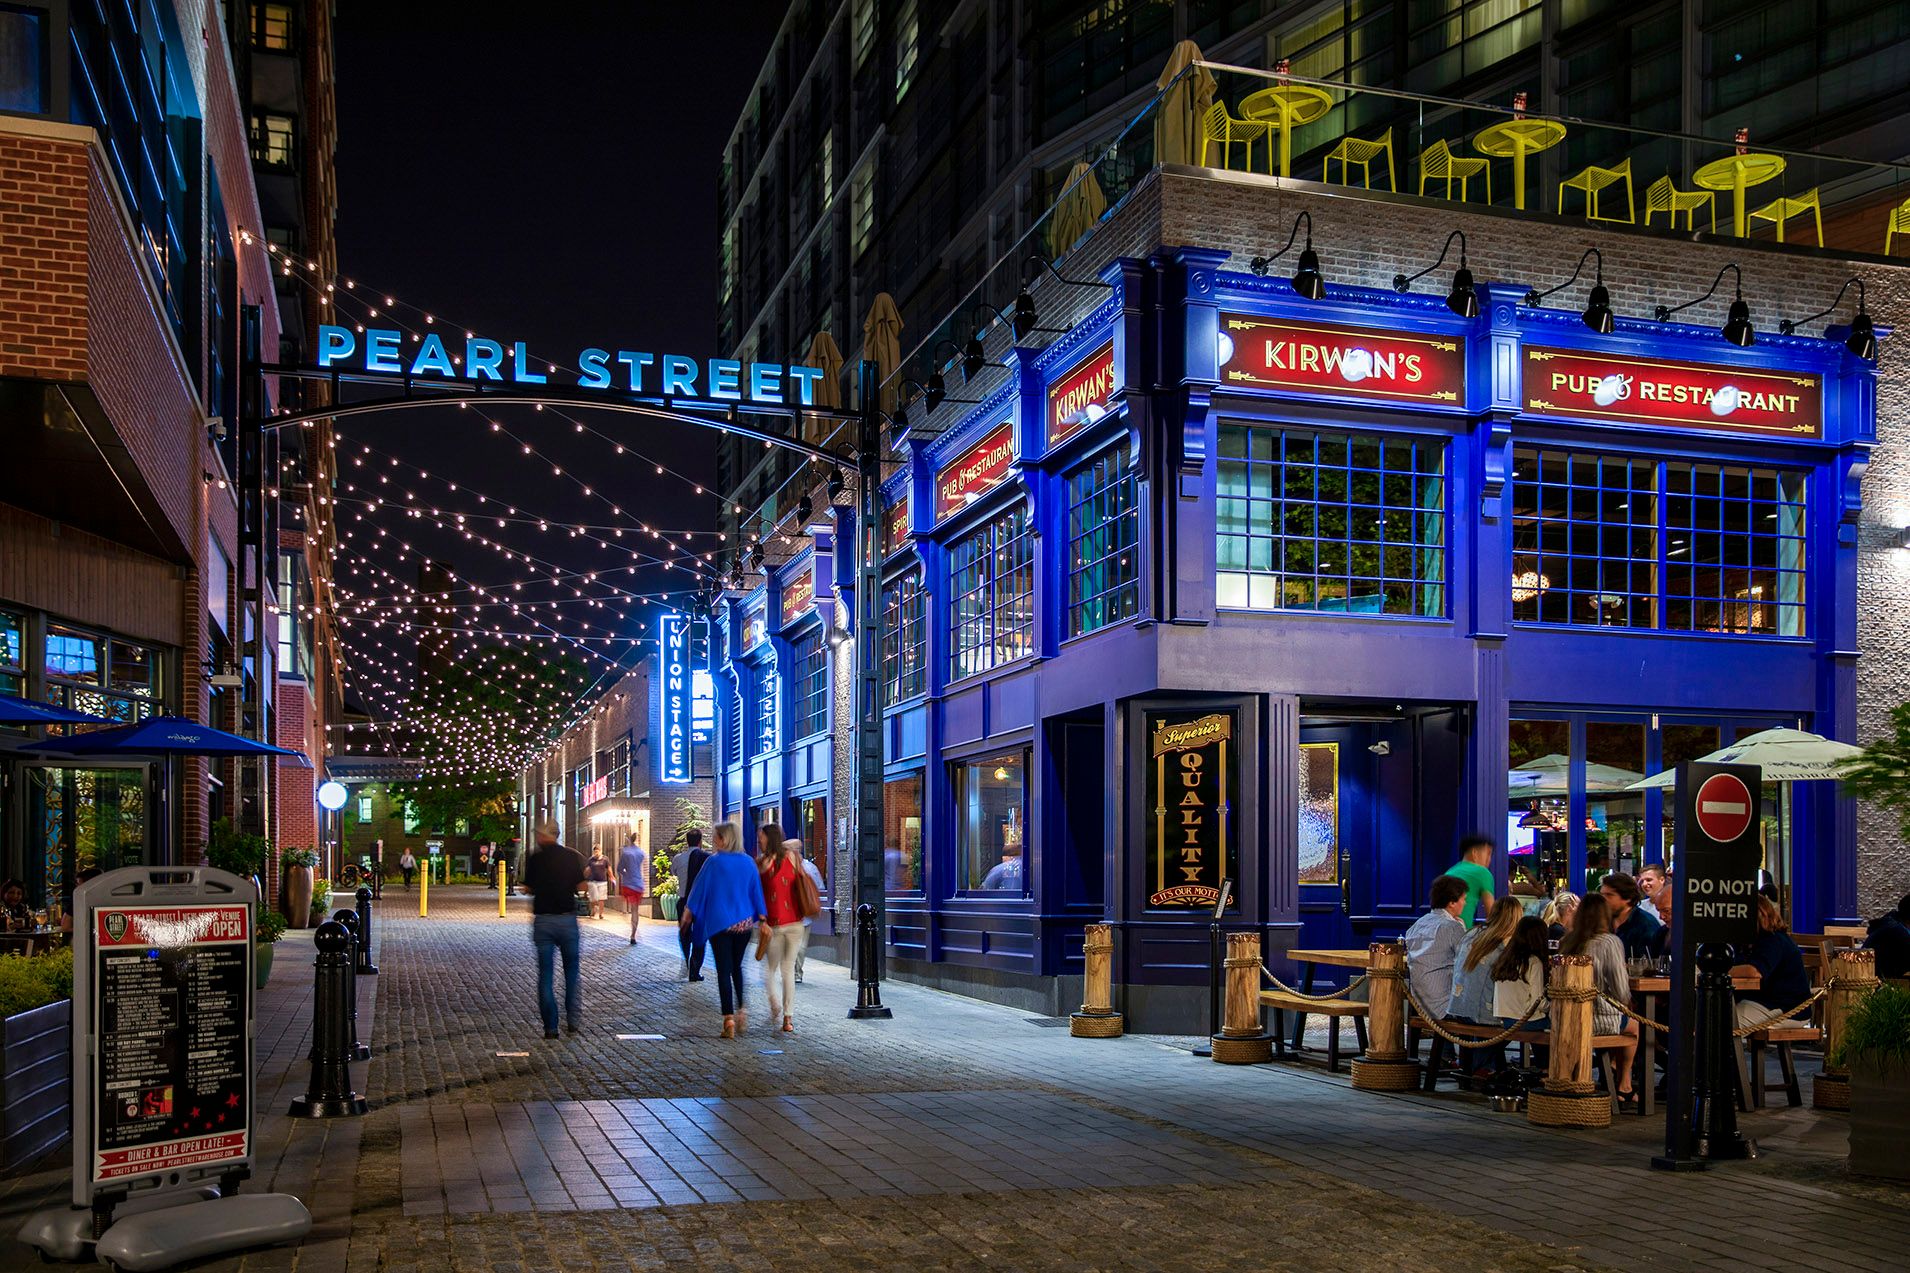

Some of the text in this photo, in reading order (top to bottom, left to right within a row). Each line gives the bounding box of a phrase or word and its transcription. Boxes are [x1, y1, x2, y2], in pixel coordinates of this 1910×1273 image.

[318, 324, 824, 406] PEARL STREET
[1551, 373, 1800, 413] PUB & RESTAURANT
[942, 479, 957, 501] PUB
[958, 467, 967, 491] &
[669, 621, 683, 764] UNION STAGE
[1163, 722, 1221, 745] Superior
[1179, 753, 1204, 881] QUALITY
[1159, 887, 1219, 900] IT'S OUR MOTT
[1688, 878, 1754, 896] DO NOT
[108, 914, 123, 923] PEARL
[221, 910, 241, 921] VENUE
[1693, 902, 1748, 918] ENTER
[109, 923, 123, 931] STREET
[212, 920, 241, 937] OPEN
[128, 1137, 224, 1162] DINER & BAR OPEN LATE!
[110, 1167, 130, 1176] TICKETS
[153, 1161, 165, 1169] NOW!
